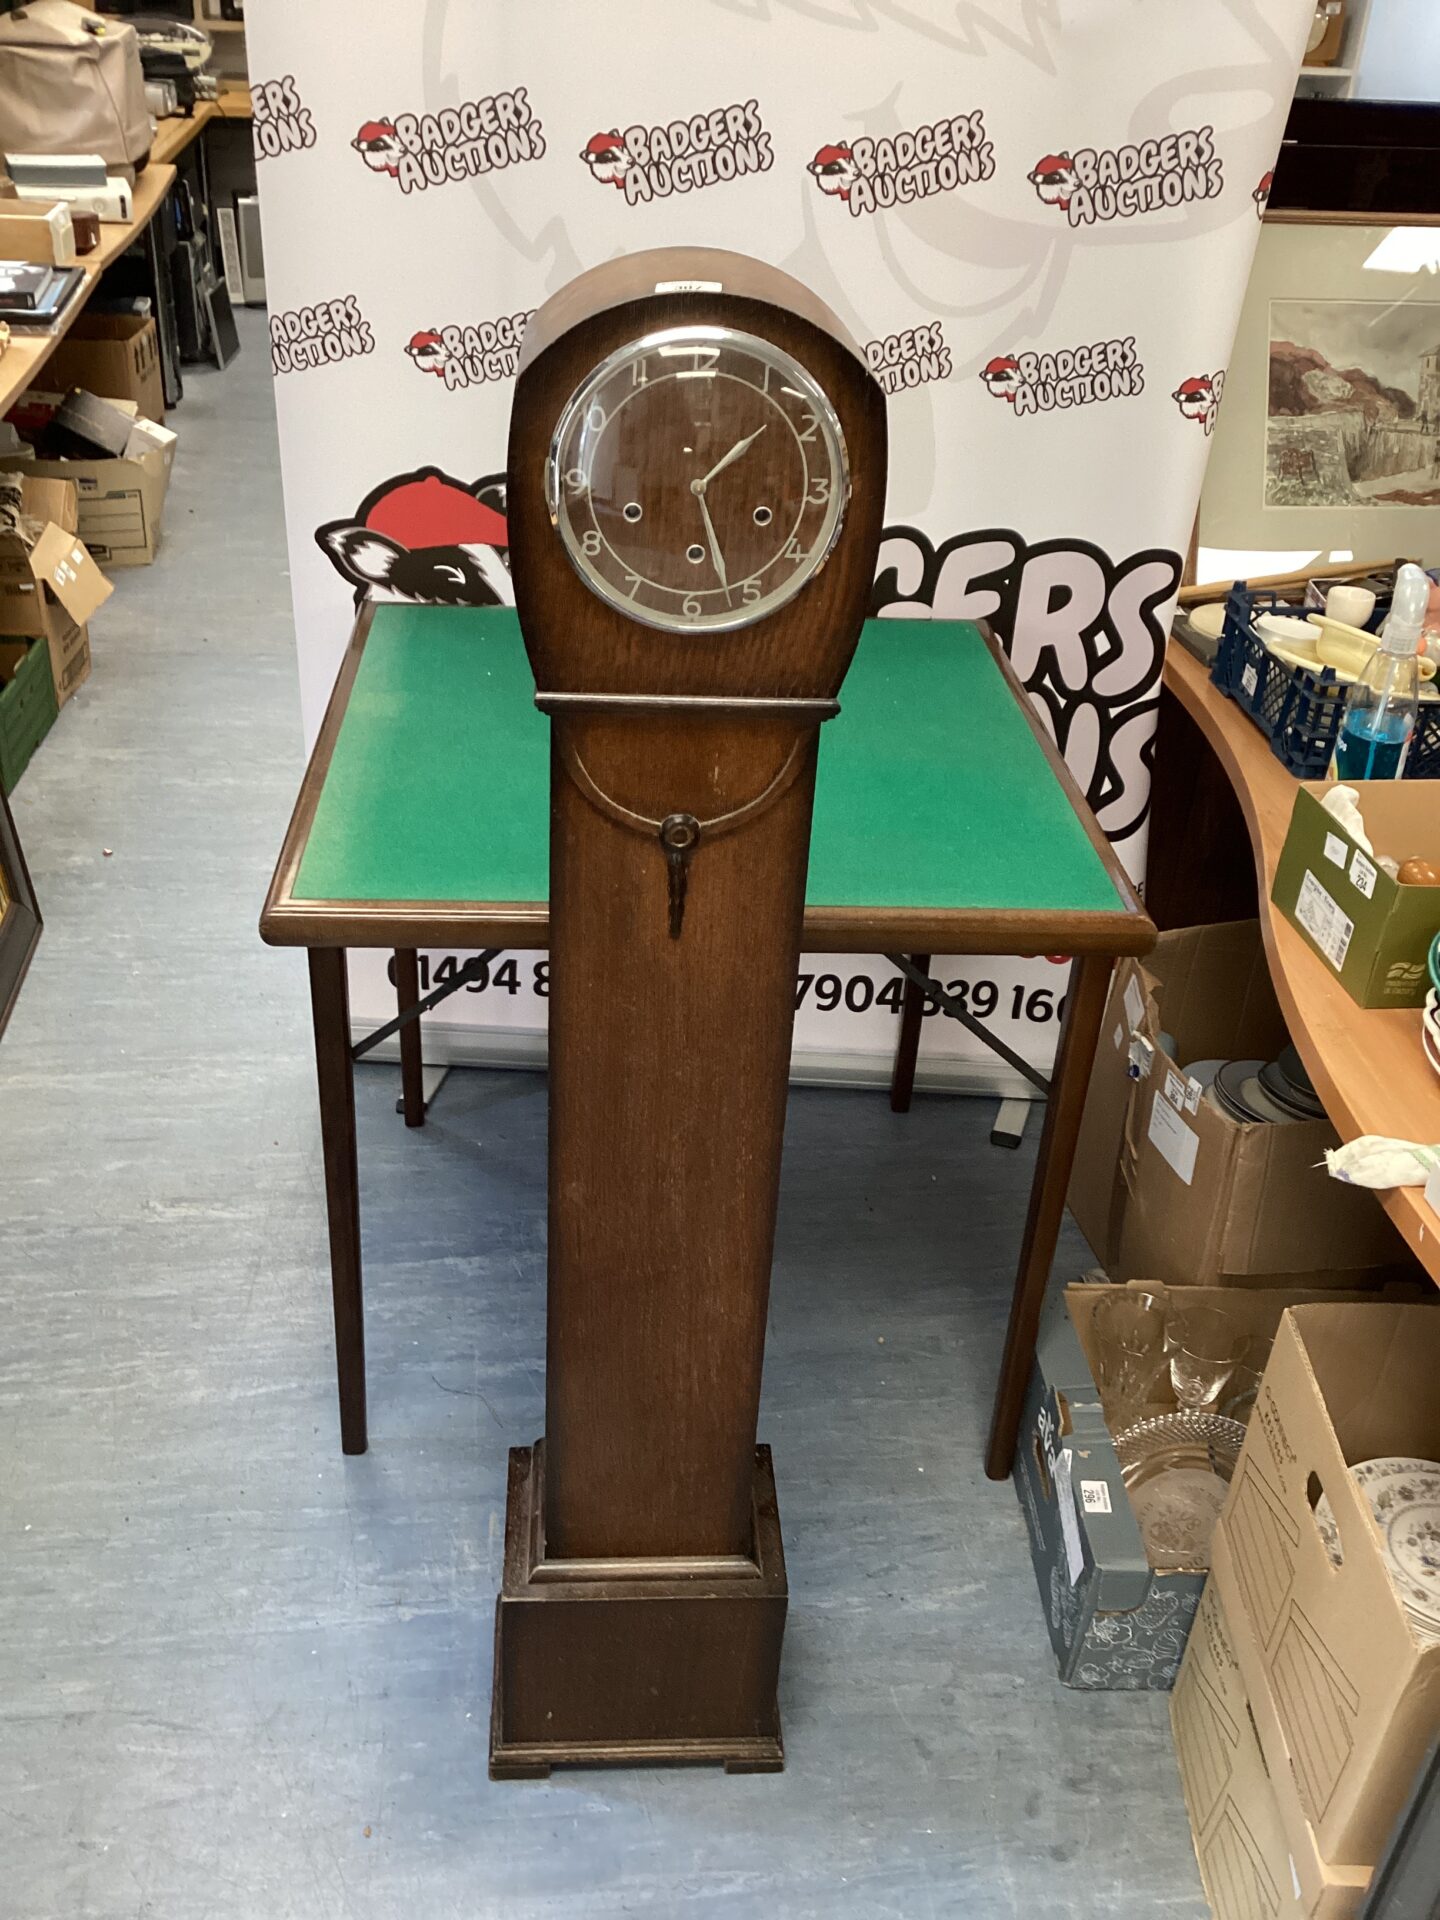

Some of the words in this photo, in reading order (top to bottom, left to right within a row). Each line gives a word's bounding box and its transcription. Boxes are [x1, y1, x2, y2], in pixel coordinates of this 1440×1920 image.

[394, 87, 532, 156] BADGERS
[623, 99, 760, 166] BADGERS
[847, 110, 985, 178] BADGERS
[398, 120, 546, 194] AUCTIONS
[623, 132, 774, 205] AUCTIONS
[848, 141, 996, 217] AUCTIONS
[1072, 125, 1214, 189] BADGERS
[1068, 158, 1223, 227] AUCTIONS
[272, 321, 375, 375] UCTIONS
[440, 309, 539, 360] BADGE
[860, 321, 943, 371] DGERS
[692, 348, 718, 372] 12
[1018, 336, 1136, 383] BADGERS
[1014, 364, 1144, 416] AUCTIONS
[801, 414, 816, 440] 2
[566, 468, 587, 494] 9
[810, 478, 831, 504] 3
[583, 531, 600, 556] 8
[784, 538, 811, 562] 4
[625, 576, 642, 600] 7
[683, 594, 702, 617] 6
[743, 580, 761, 604] 5
[1011, 984, 1066, 1023] 16
[1083, 1489, 1096, 1503] 296
